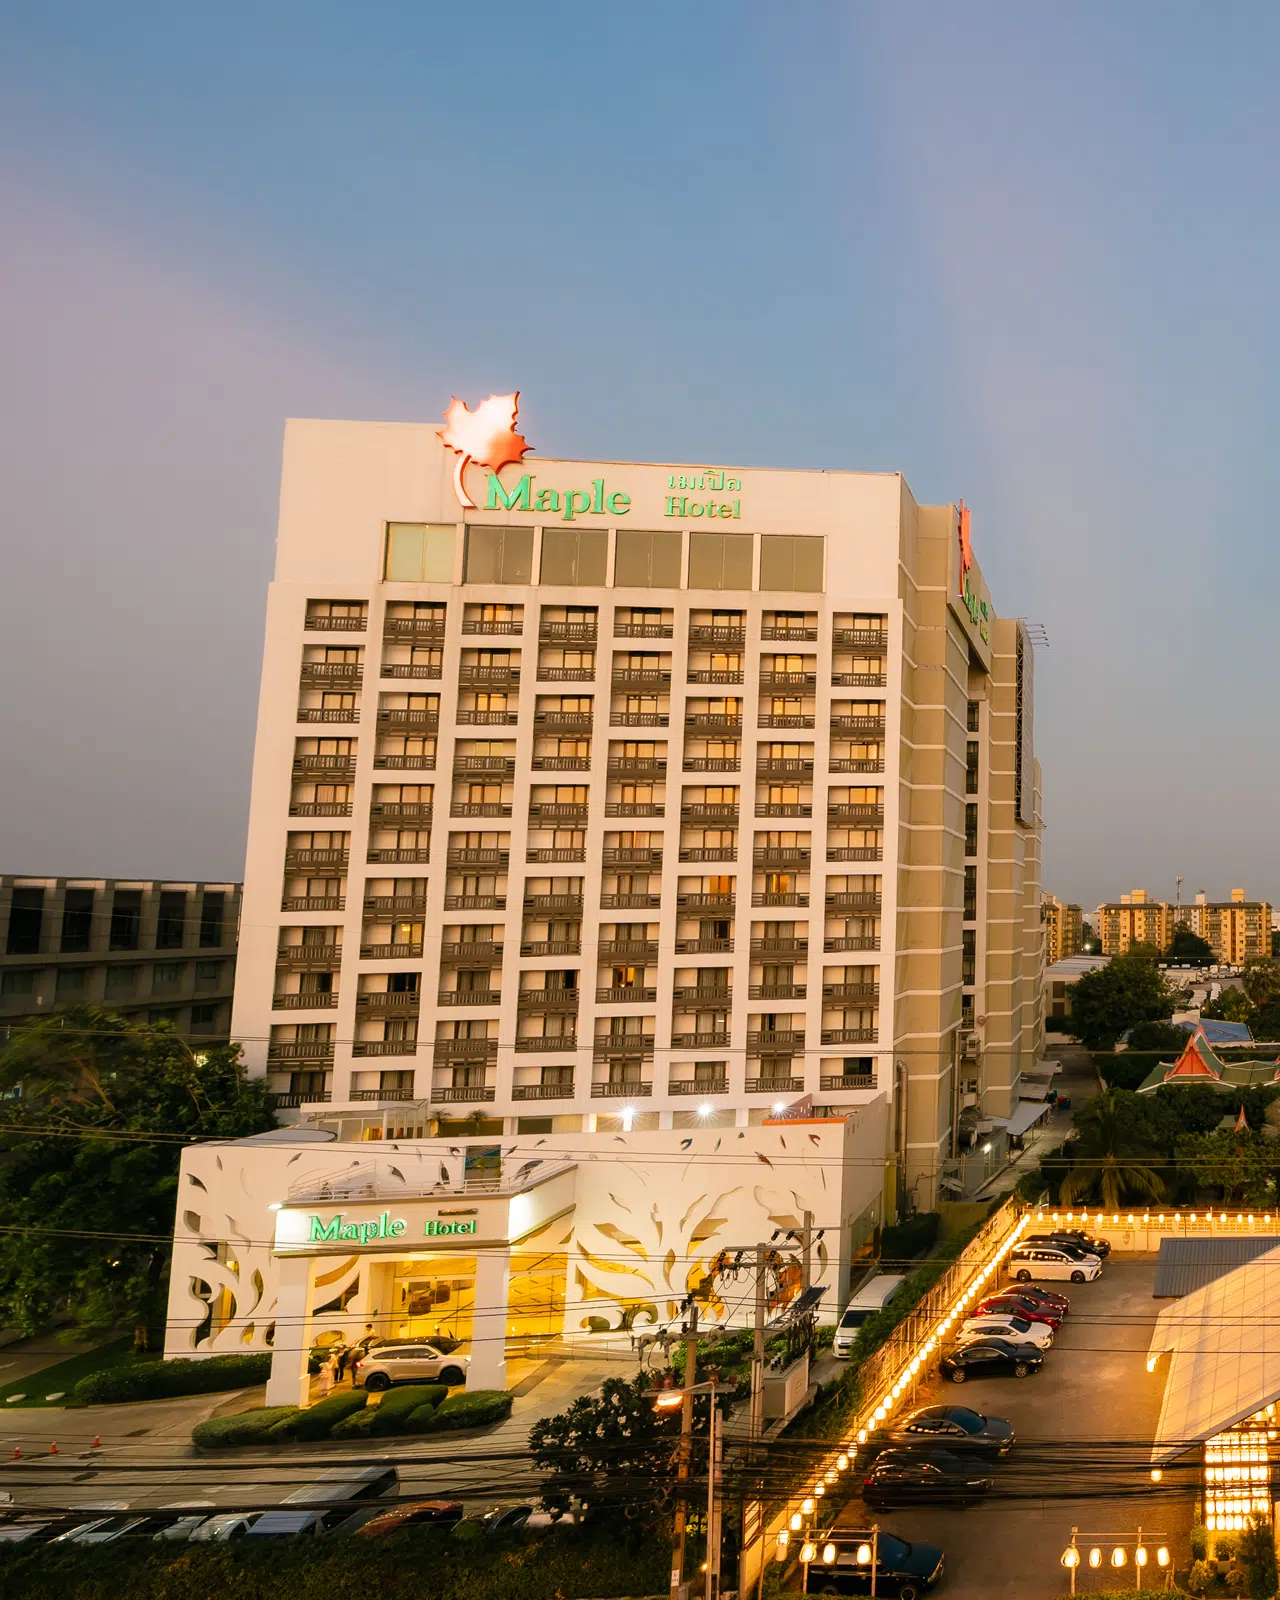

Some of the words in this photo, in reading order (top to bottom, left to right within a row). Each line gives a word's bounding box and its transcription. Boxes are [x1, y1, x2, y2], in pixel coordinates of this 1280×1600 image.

[668, 470, 742, 491] เมเปิล
[483, 473, 632, 521] Maple
[664, 495, 742, 519] Hotel
[307, 1213, 405, 1244] Maple
[424, 1220, 477, 1236] Hotel
